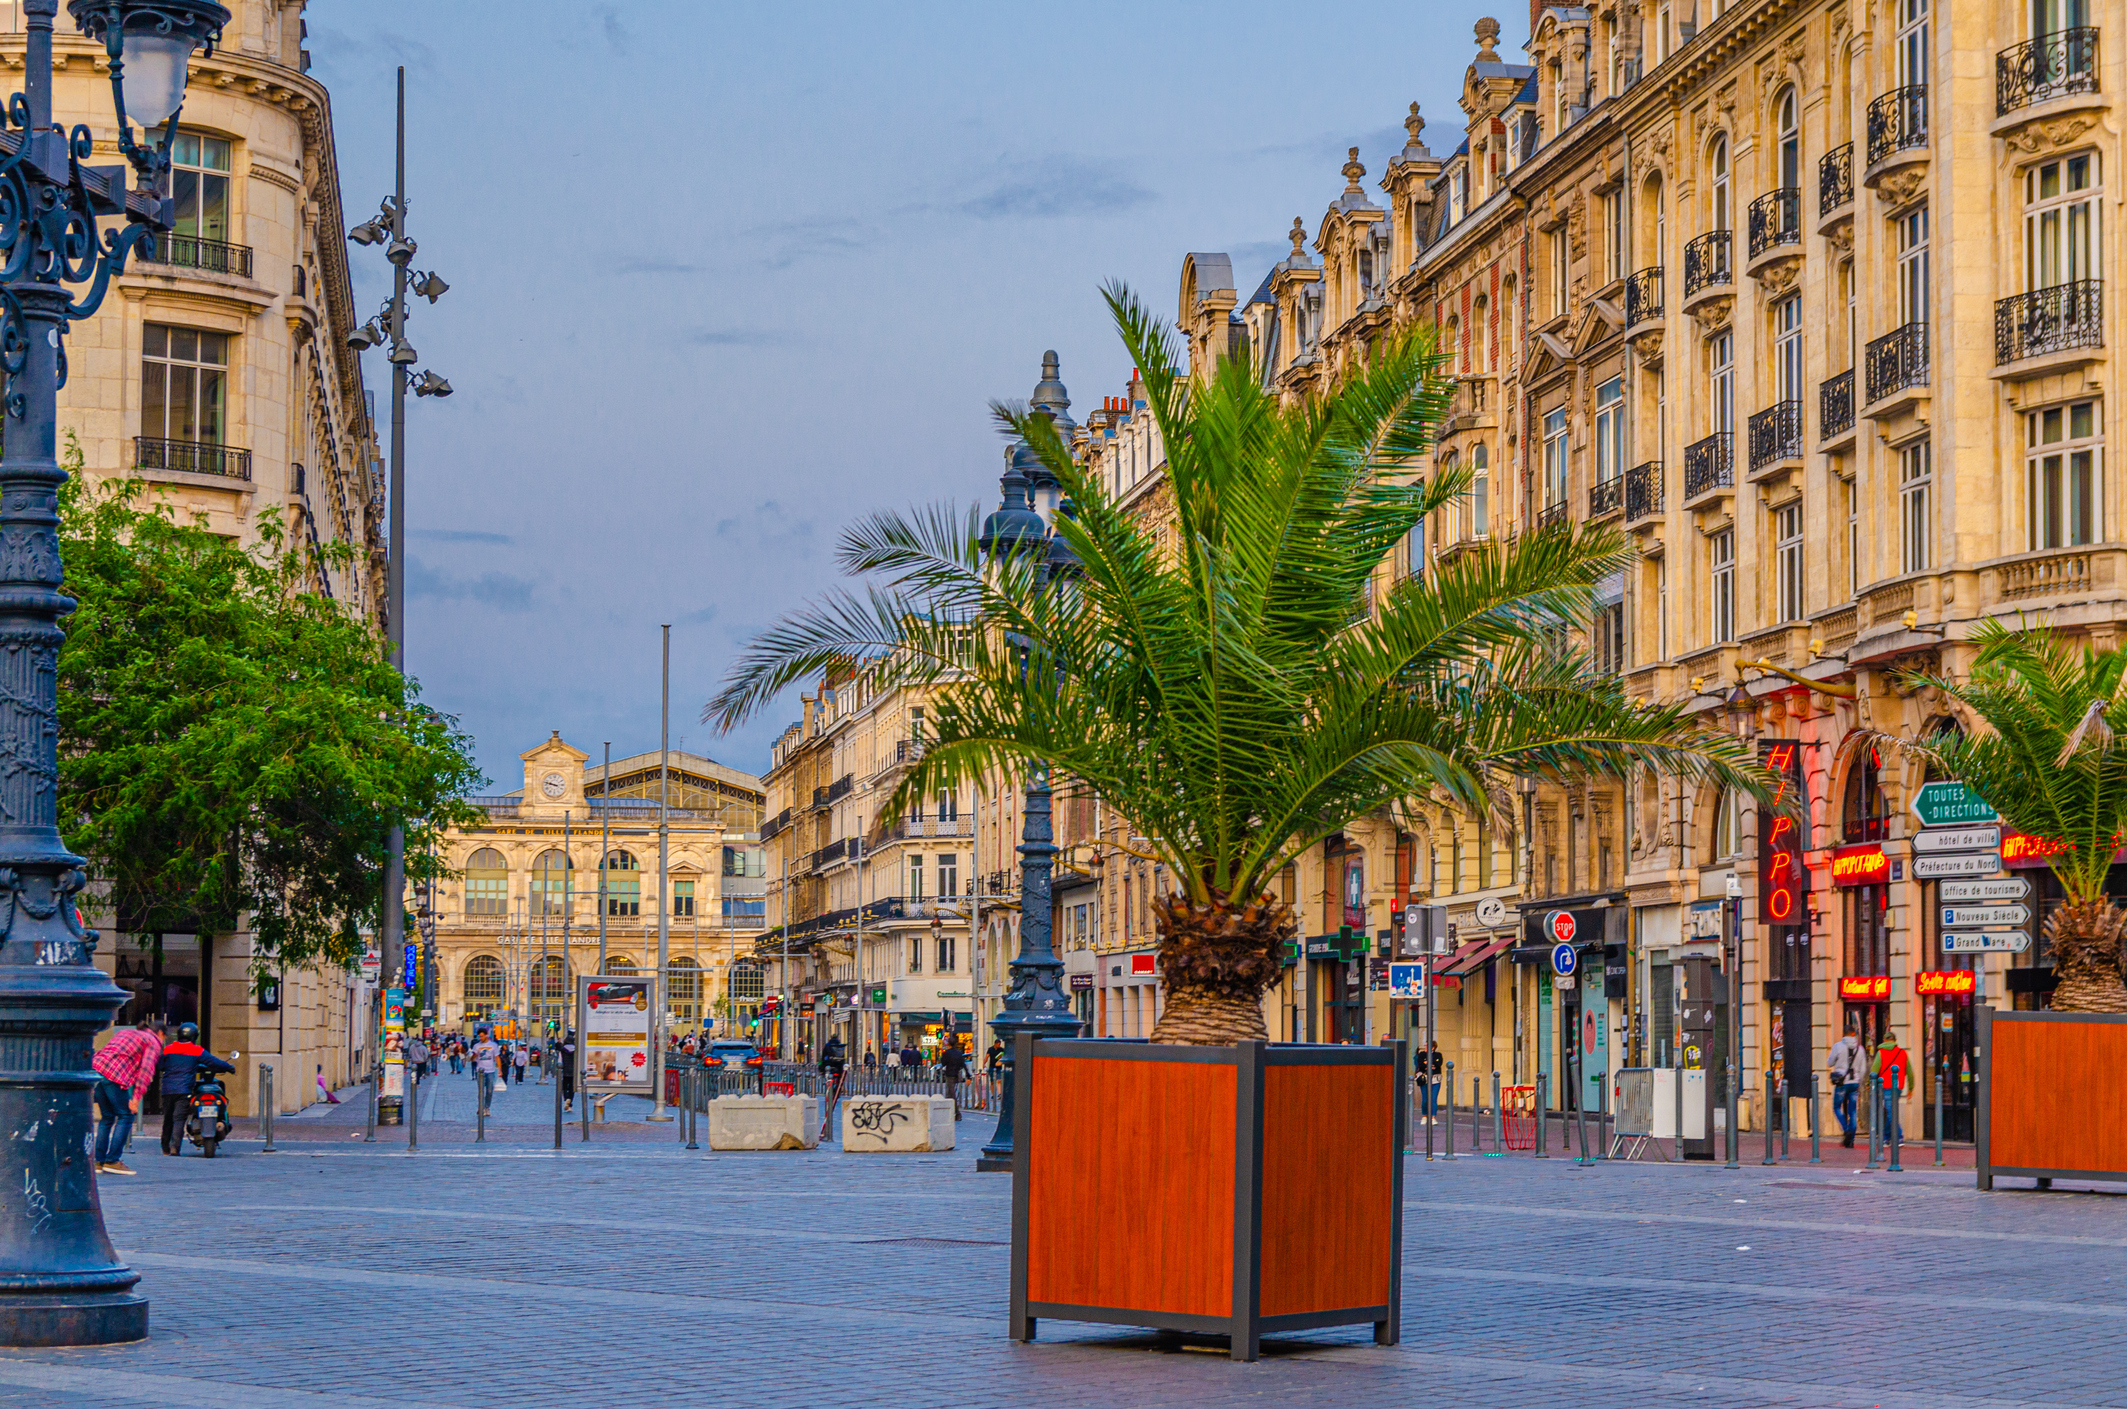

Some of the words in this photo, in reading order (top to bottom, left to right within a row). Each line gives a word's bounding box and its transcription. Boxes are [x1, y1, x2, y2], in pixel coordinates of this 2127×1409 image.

[1928, 788, 1965, 803] TOUTES
[1766, 744, 1794, 919] HIPPO
[1939, 833, 1959, 846] hôtel
[1963, 835, 1972, 844] de
[1977, 833, 1995, 844] ville
[1920, 860, 1960, 872] Préfecture
[1965, 860, 1974, 870] du
[1977, 859, 1996, 870] Nord
[1945, 885, 1967, 896] office
[1971, 885, 1980, 895] de
[1985, 884, 2020, 895] tourisme
[1956, 911, 1989, 922] Nouveau
[1993, 910, 2019, 921] Siècle
[1556, 923, 1573, 932] STOP
[1956, 937, 1980, 947] Grand
[405, 945, 417, 986] HOTEL
